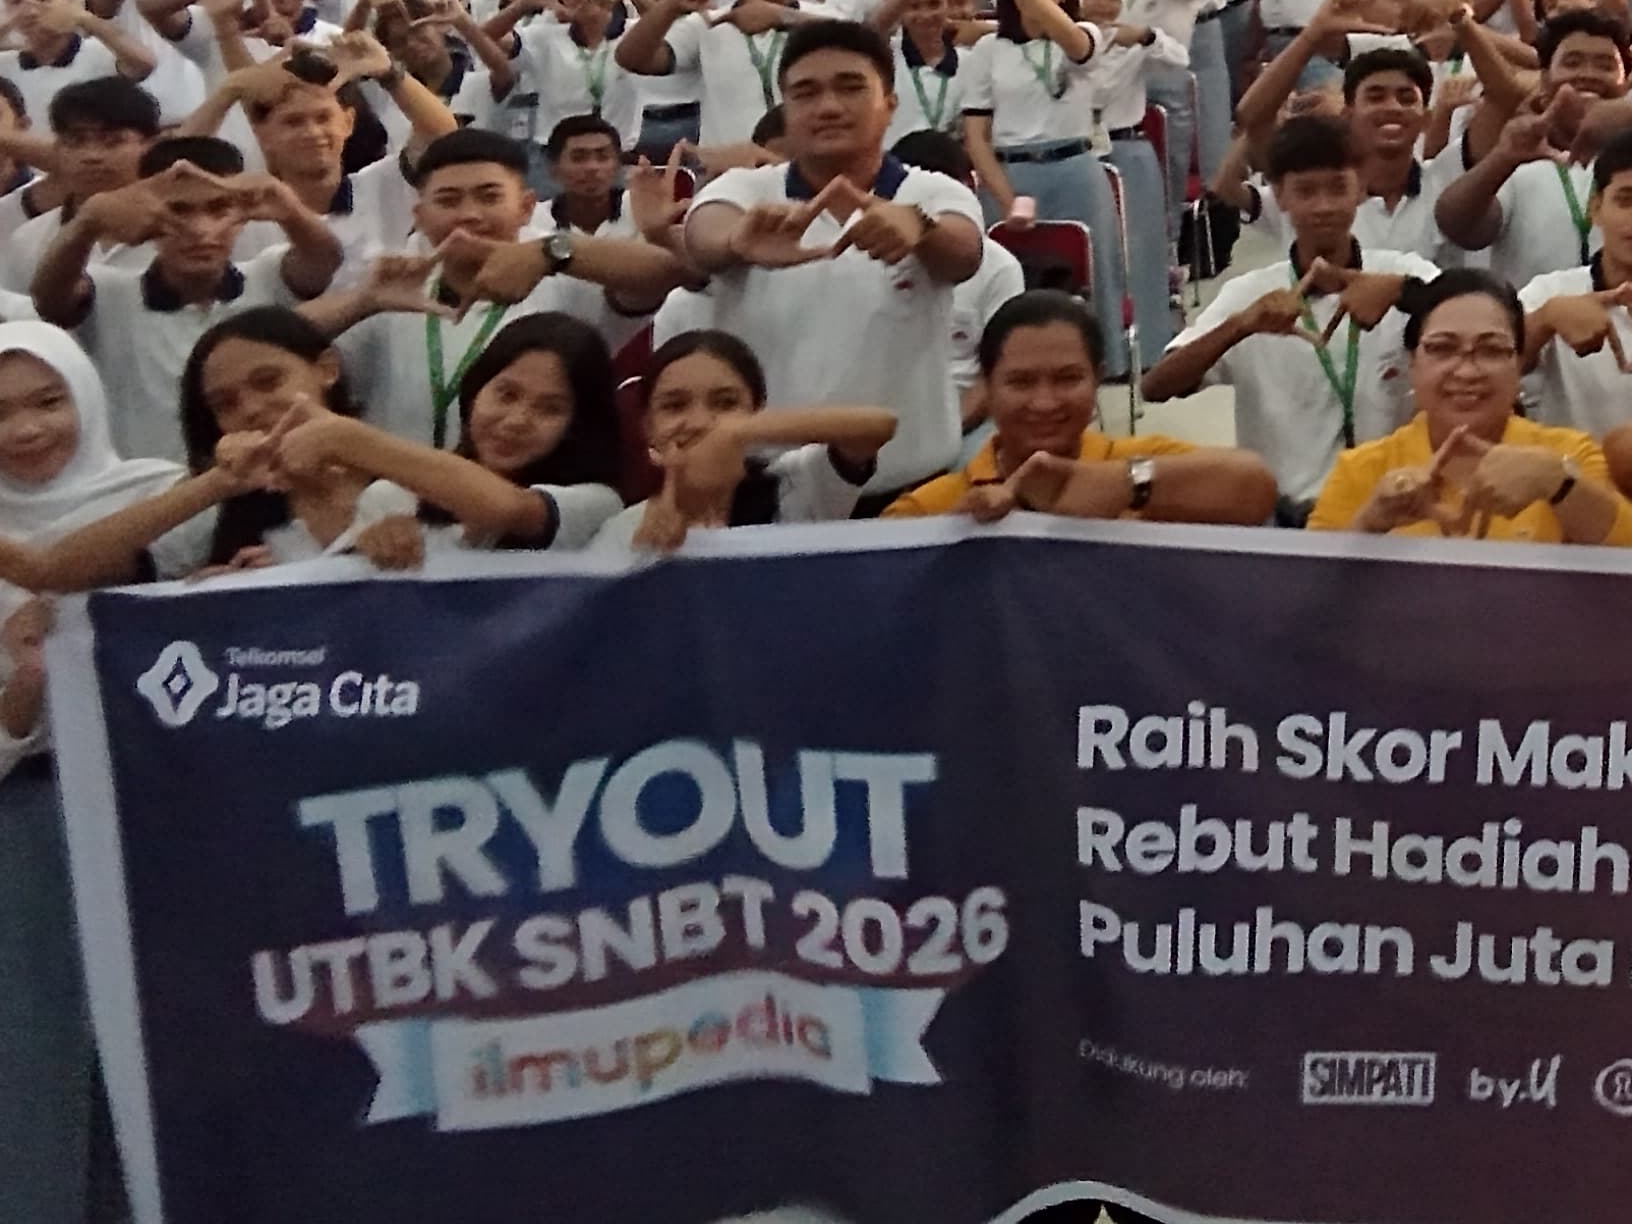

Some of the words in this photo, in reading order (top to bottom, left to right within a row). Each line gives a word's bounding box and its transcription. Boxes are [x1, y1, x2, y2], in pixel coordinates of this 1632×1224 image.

[224, 645, 325, 666] Telkomsel
[216, 672, 321, 729] Jaga
[329, 670, 420, 717] Cita
[1076, 701, 1259, 772] Raih
[1276, 711, 1462, 782] Skor
[294, 738, 938, 915] TRYOUT
[1076, 805, 1317, 875] Rebut
[1335, 817, 1630, 894] Hadiah
[252, 918, 496, 1024] UTBK
[513, 874, 774, 989] SNBT
[790, 886, 1009, 974] 2026
[1080, 901, 1413, 976] Puluhan
[1431, 921, 1613, 987] Juta
[472, 990, 833, 1096] ilmupedia
[1307, 1055, 1433, 1099] SIMPATI
[1470, 1054, 1561, 1108] by.U
